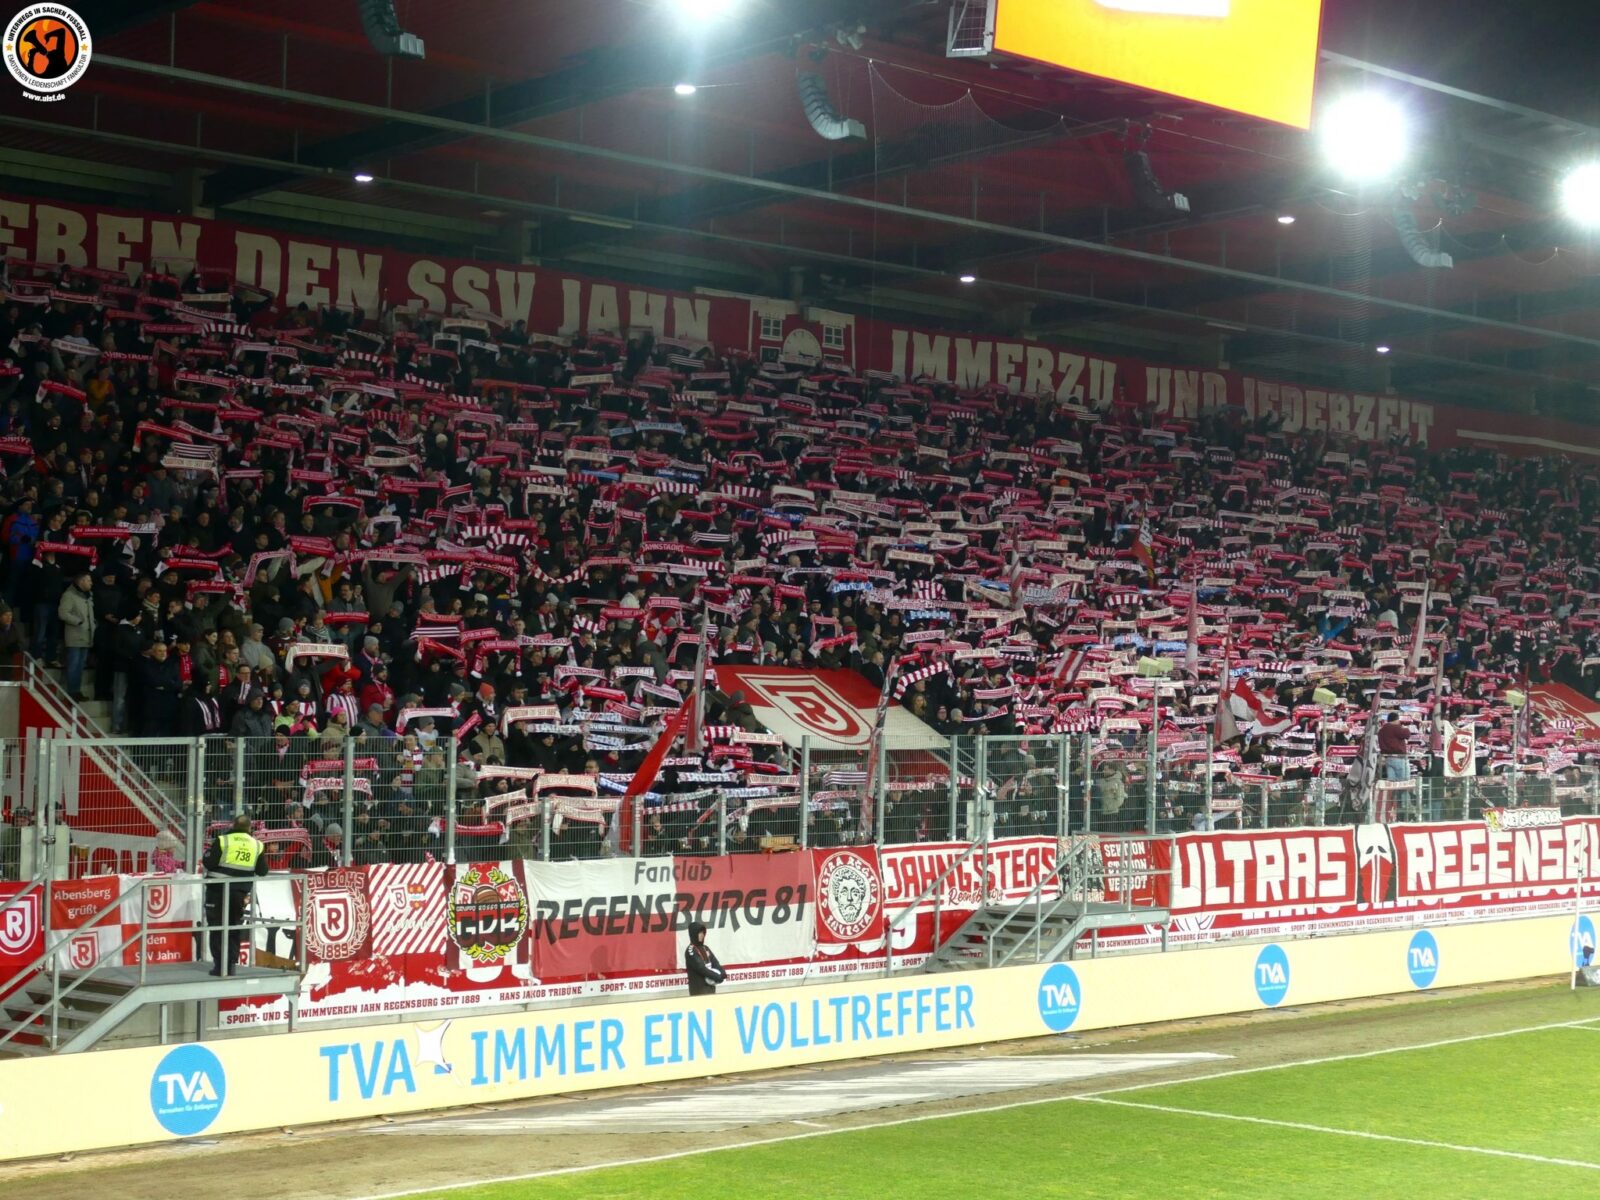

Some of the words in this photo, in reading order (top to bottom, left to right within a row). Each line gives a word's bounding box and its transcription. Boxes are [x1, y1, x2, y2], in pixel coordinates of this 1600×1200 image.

[235, 230, 382, 320] DEN
[407, 259, 535, 332] SSV
[558, 278, 711, 341] JAHN
[891, 329, 1117, 409] IMMERZU
[1145, 366, 1228, 419] UND
[235, 850, 251, 862] 738
[1103, 841, 1145, 858] SEKTON
[327, 871, 366, 889] BOYS
[634, 860, 712, 885] Fanclub
[886, 845, 1058, 898] JAHNGSTERS
[1172, 836, 1347, 907] ULTRAS
[821, 856, 844, 908] CASTRA
[54, 887, 112, 900] Abensberg
[68, 903, 98, 919] grüßt
[536, 889, 770, 944] REGENSBURG
[772, 884, 807, 923] 81
[827, 913, 872, 936] INVICTA
[147, 935, 167, 945] den
[1098, 939, 1106, 948] ND
[135, 951, 154, 962] SV
[156, 949, 181, 961] Jahn
[321, 942, 350, 960] 1889
[1410, 947, 1436, 967] TVA
[819, 964, 837, 974] HANS
[838, 963, 858, 973] JAKOB
[902, 957, 924, 967] SPORT-
[726, 969, 769, 981] REGENSBURG
[771, 968, 786, 978] SEIT
[788, 967, 804, 976] 1889
[1258, 963, 1286, 985] TVA
[500, 992, 520, 1001] HANS
[522, 990, 546, 999] JAKOB
[549, 985, 582, 997] TRIBÜNE
[600, 982, 627, 993] SPORT-
[629, 981, 643, 990] UND
[1041, 983, 1077, 1008] TVA
[227, 1013, 260, 1024] SPORT-
[262, 1011, 280, 1021] UND
[360, 1003, 381, 1013] JAHN
[384, 998, 438, 1012] REGENSBURG
[440, 996, 459, 1006] SEIT
[461, 994, 480, 1004] 1889
[320, 1039, 417, 1101] TVA
[470, 1018, 626, 1086] IMMER
[643, 1009, 714, 1067] EIN
[734, 984, 976, 1055] VOLLTREFFER
[158, 1071, 218, 1105] TVA
